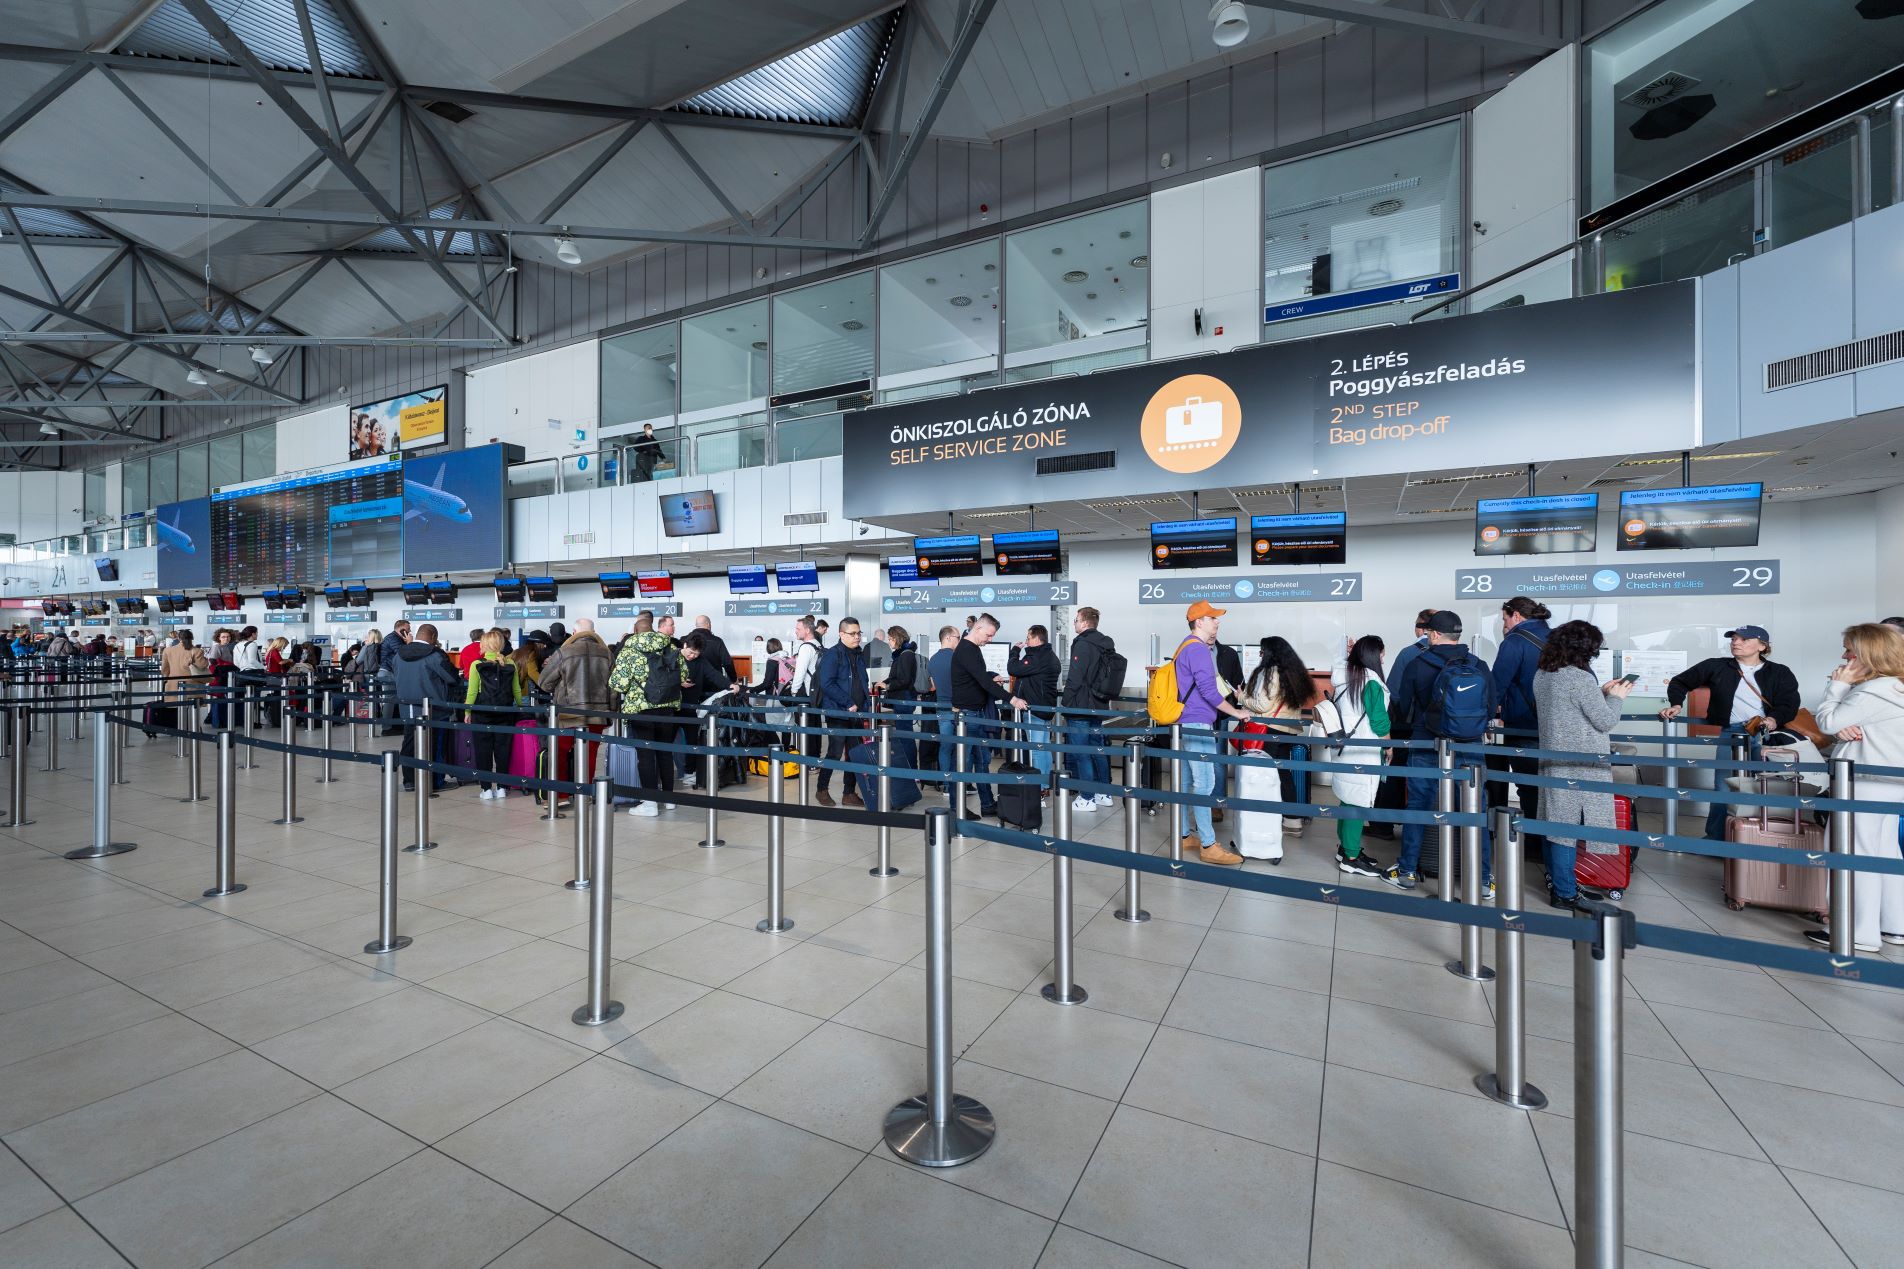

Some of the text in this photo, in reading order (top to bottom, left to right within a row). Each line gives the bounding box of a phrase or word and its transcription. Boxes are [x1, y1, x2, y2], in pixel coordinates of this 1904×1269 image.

[1408, 283, 1431, 295] LOT
[1281, 306, 1304, 316] CREW
[1330, 351, 1409, 376] 2. LÉPÉS
[1329, 357, 1526, 397] Poggyászfeladás
[1372, 401, 1420, 419] STEP
[890, 402, 1091, 443] ÖNKISZOLGÁLÓ ZÓNA
[1330, 415, 1451, 446] Bag drop-off
[890, 429, 1067, 465] SELF SERVICE ZONE
[1710, 486, 1752, 495] utasfelvétel
[1484, 499, 1510, 507] Currently
[1522, 497, 1548, 505] check-in
[1533, 573, 1587, 582] Utasfelvétel
[1626, 570, 1685, 580] Utasfelvétel
[1732, 566, 1773, 587] 29
[1192, 583, 1231, 591] Utasfelvétel
[1257, 581, 1299, 589] Utasfelvétel
[1330, 578, 1357, 596] 27
[1461, 575, 1492, 593] 28
[1516, 584, 1557, 592] Check-in
[1626, 581, 1672, 590] Check-in
[1050, 586, 1070, 600] 25
[1142, 583, 1165, 599] 26
[1181, 591, 1210, 599] Check-in
[1257, 589, 1289, 597] Check-in
[913, 590, 930, 604] 24
[600, 606, 608, 616] 19
[665, 605, 676, 615] 20
[728, 603, 737, 613] 21
[810, 601, 822, 612] 22
[496, 609, 503, 618] 17
[549, 607, 557, 617] 18
[1649, 840, 1665, 849] bud
[1809, 858, 1826, 867] bud
[1322, 893, 1340, 904] bud
[1505, 920, 1525, 931] bud
[1834, 966, 1861, 980] bud
